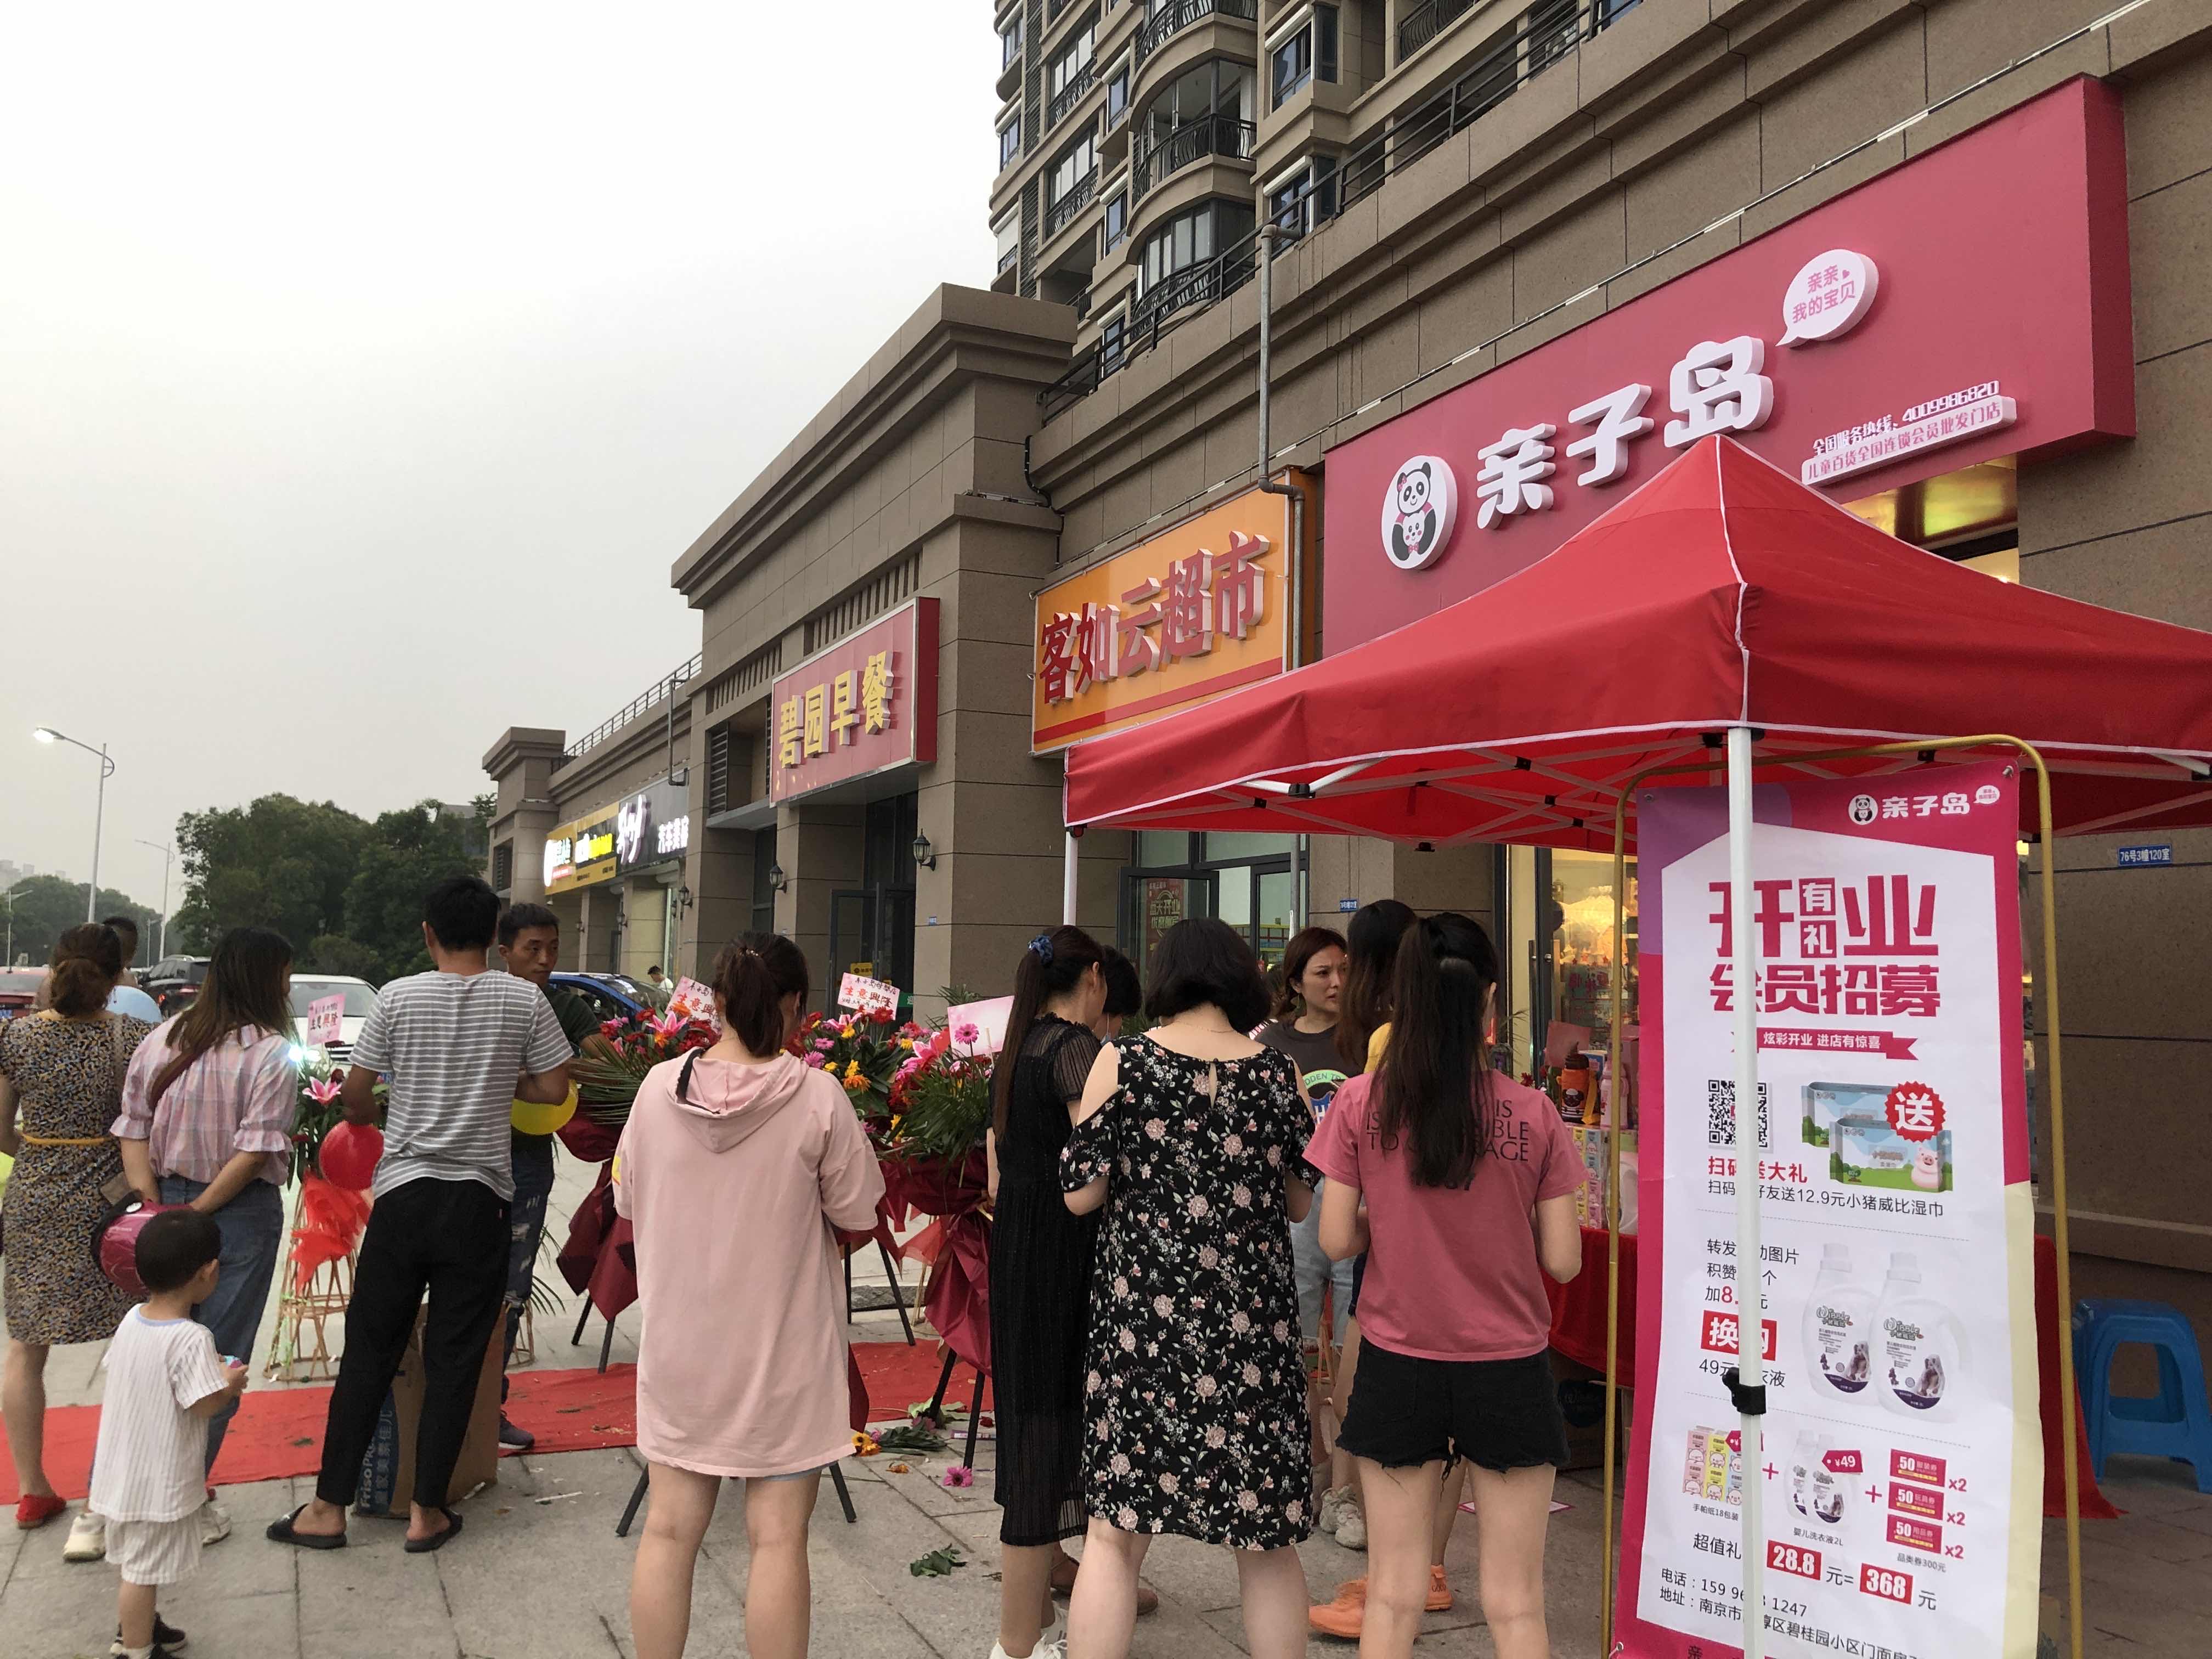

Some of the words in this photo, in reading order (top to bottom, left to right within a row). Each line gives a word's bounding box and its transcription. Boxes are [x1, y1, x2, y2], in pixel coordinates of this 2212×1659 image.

[1808, 264, 1839, 294] 亲亲
[1792, 280, 1855, 324] 我的宝贝
[1477, 335, 1773, 530] 亲子岛
[1807, 400, 2001, 481] 儿童百货全国连锁会员批发门店
[1040, 530, 1270, 704] 客如云超市
[779, 650, 895, 769] 碧园早餐
[1882, 792, 1971, 819] 亲子岛
[2120, 849, 2170, 862] 76号3幢120室
[1710, 964, 1940, 1017] 会员招募
[1763, 1031, 1813, 1047] 炫彩开业
[1816, 1033, 1881, 1049] 进店有惊喜
[1304, 1073, 1328, 1086] DDEN
[1895, 1092, 1936, 1132] 送
[1492, 1118, 1529, 1141] BLE
[1793, 1527, 1843, 1547] 婴儿洗衣液2L
[1866, 1568, 1906, 1599] 368
